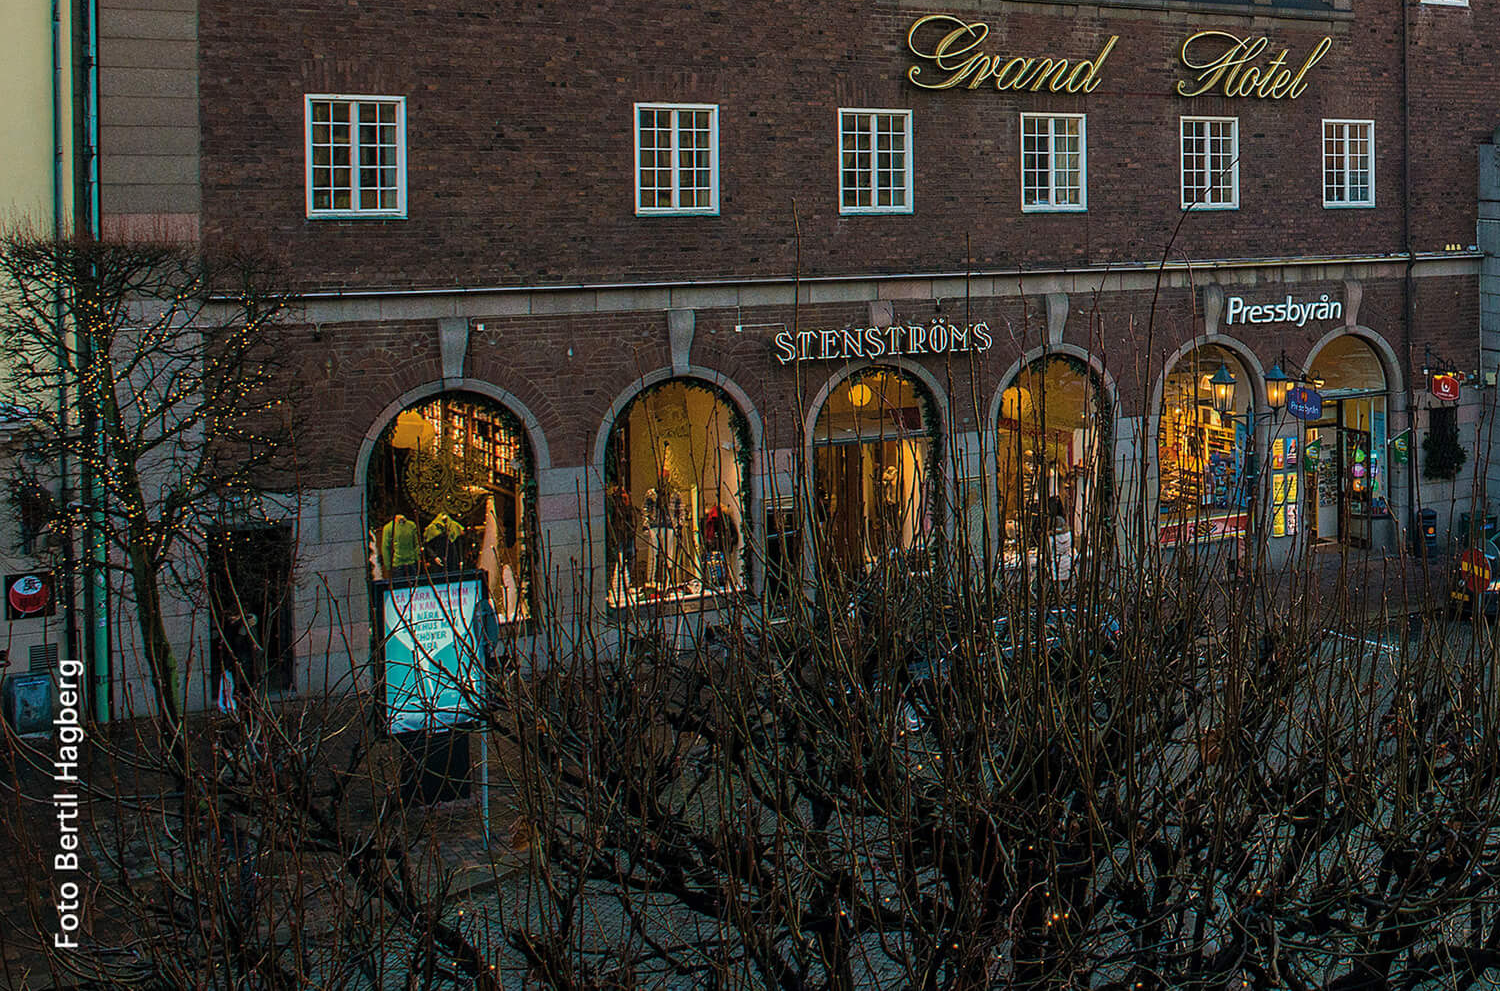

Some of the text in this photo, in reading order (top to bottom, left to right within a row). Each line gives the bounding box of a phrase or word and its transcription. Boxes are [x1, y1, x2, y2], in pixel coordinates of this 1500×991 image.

[908, 14, 1332, 100] Grand Hotel
[1225, 294, 1342, 327] Pressbyrån
[774, 317, 993, 366] STENSTRÖMS
